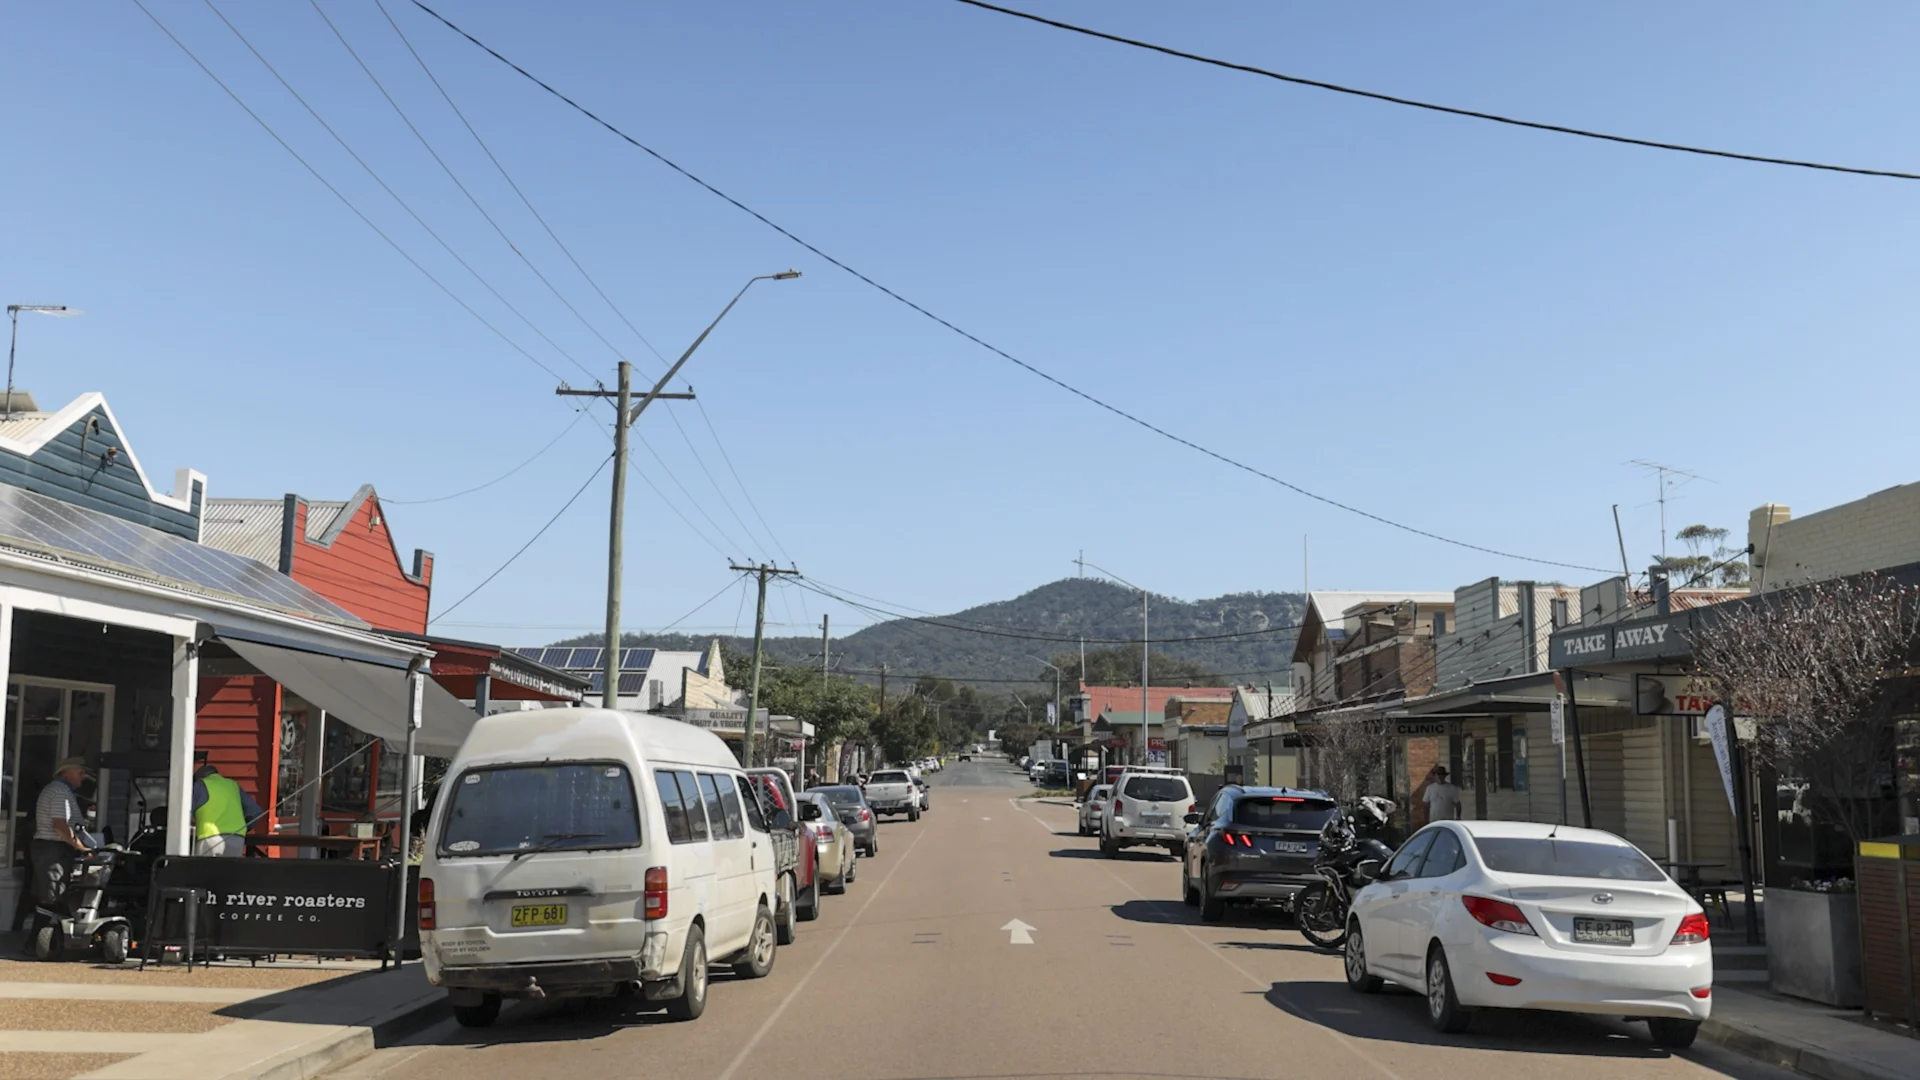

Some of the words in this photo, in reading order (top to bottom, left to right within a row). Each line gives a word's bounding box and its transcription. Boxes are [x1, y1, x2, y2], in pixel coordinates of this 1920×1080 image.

[1564, 633, 1606, 655] TAKE
[1615, 623, 1669, 649] AWAY
[709, 711, 744, 720] QUALITY
[1397, 724, 1445, 735] CLINIC
[226, 892, 278, 906] river
[283, 894, 366, 908] roasters
[219, 912, 283, 922] COFFEE
[298, 914, 321, 922] CO.
